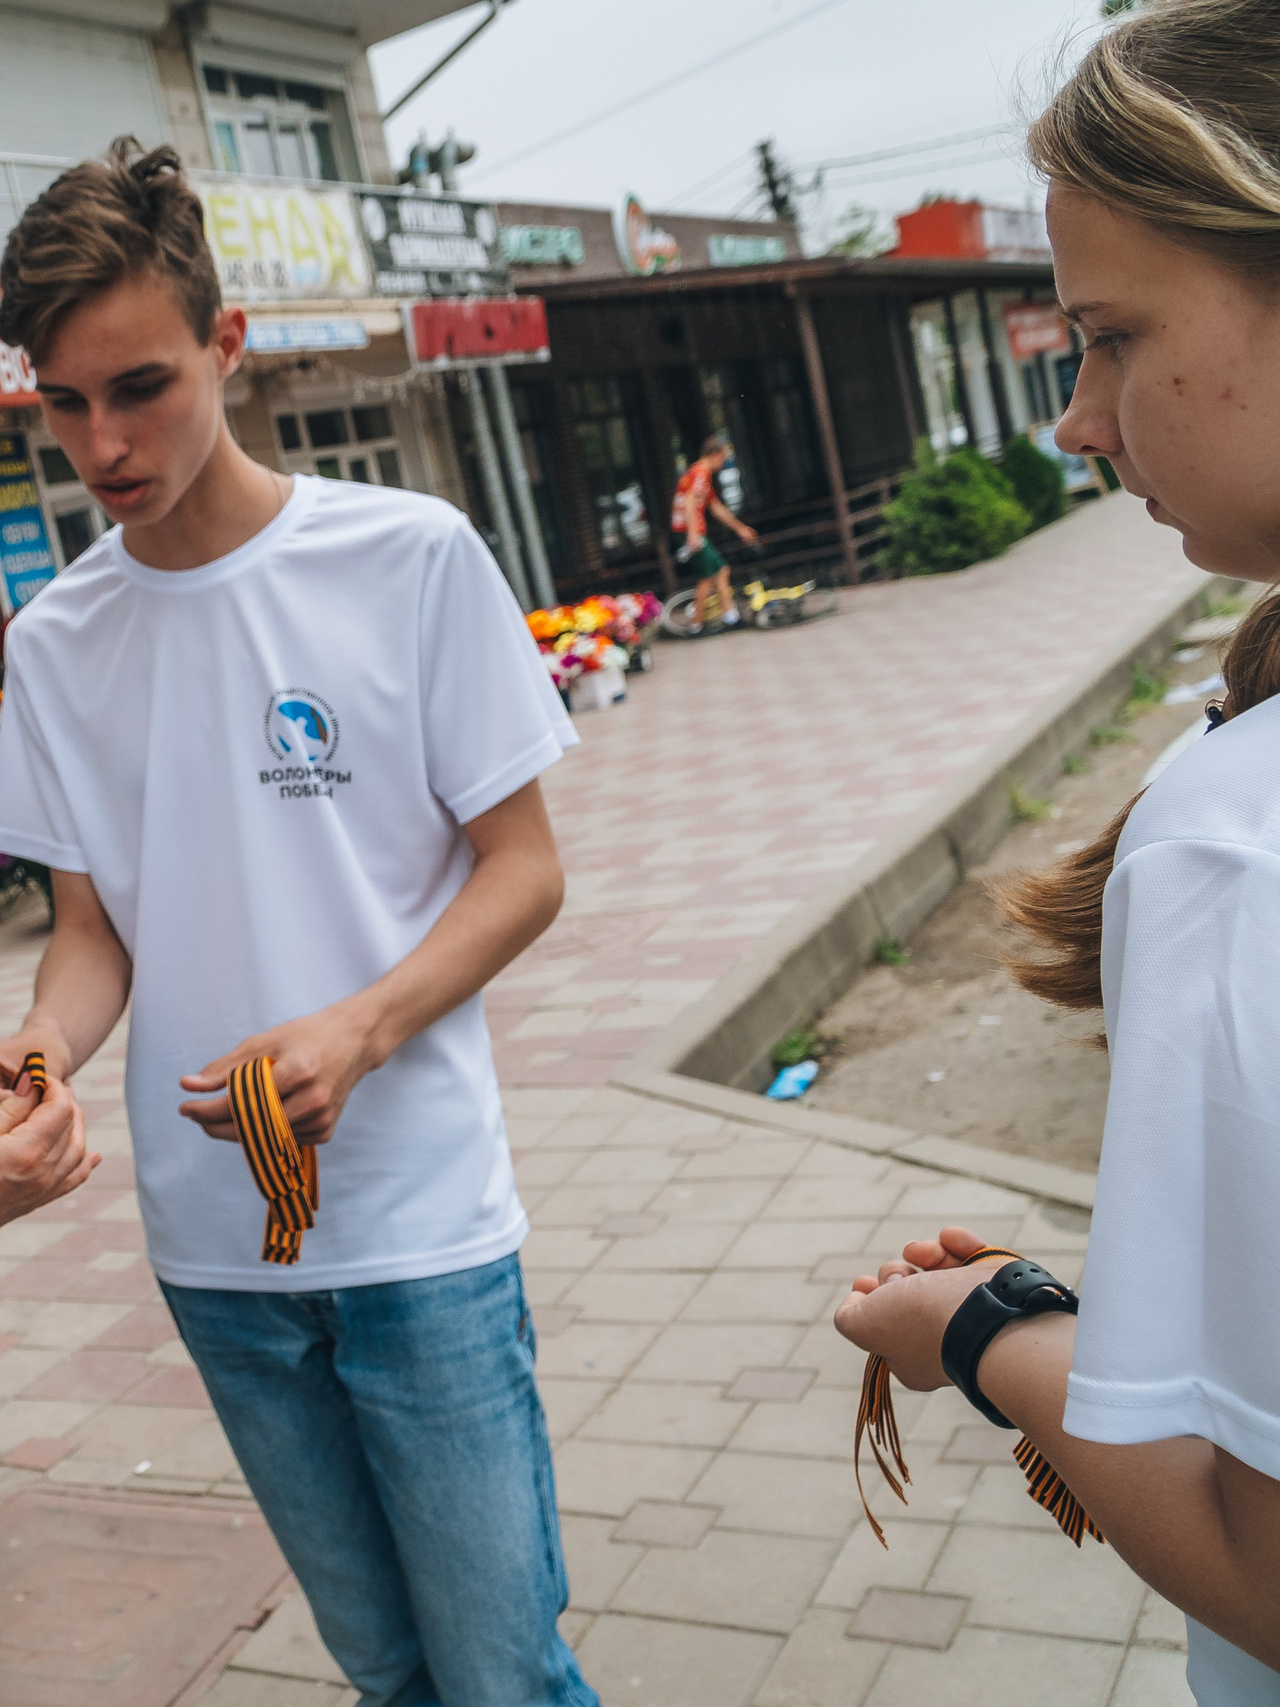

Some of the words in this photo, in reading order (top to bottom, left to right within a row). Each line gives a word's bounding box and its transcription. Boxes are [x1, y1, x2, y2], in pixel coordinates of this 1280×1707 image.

[204, 194, 357, 288] ЕНДА
[259, 766, 352, 785] ВОЛОРЫ
[279, 784, 334, 799] ПОБЕ
